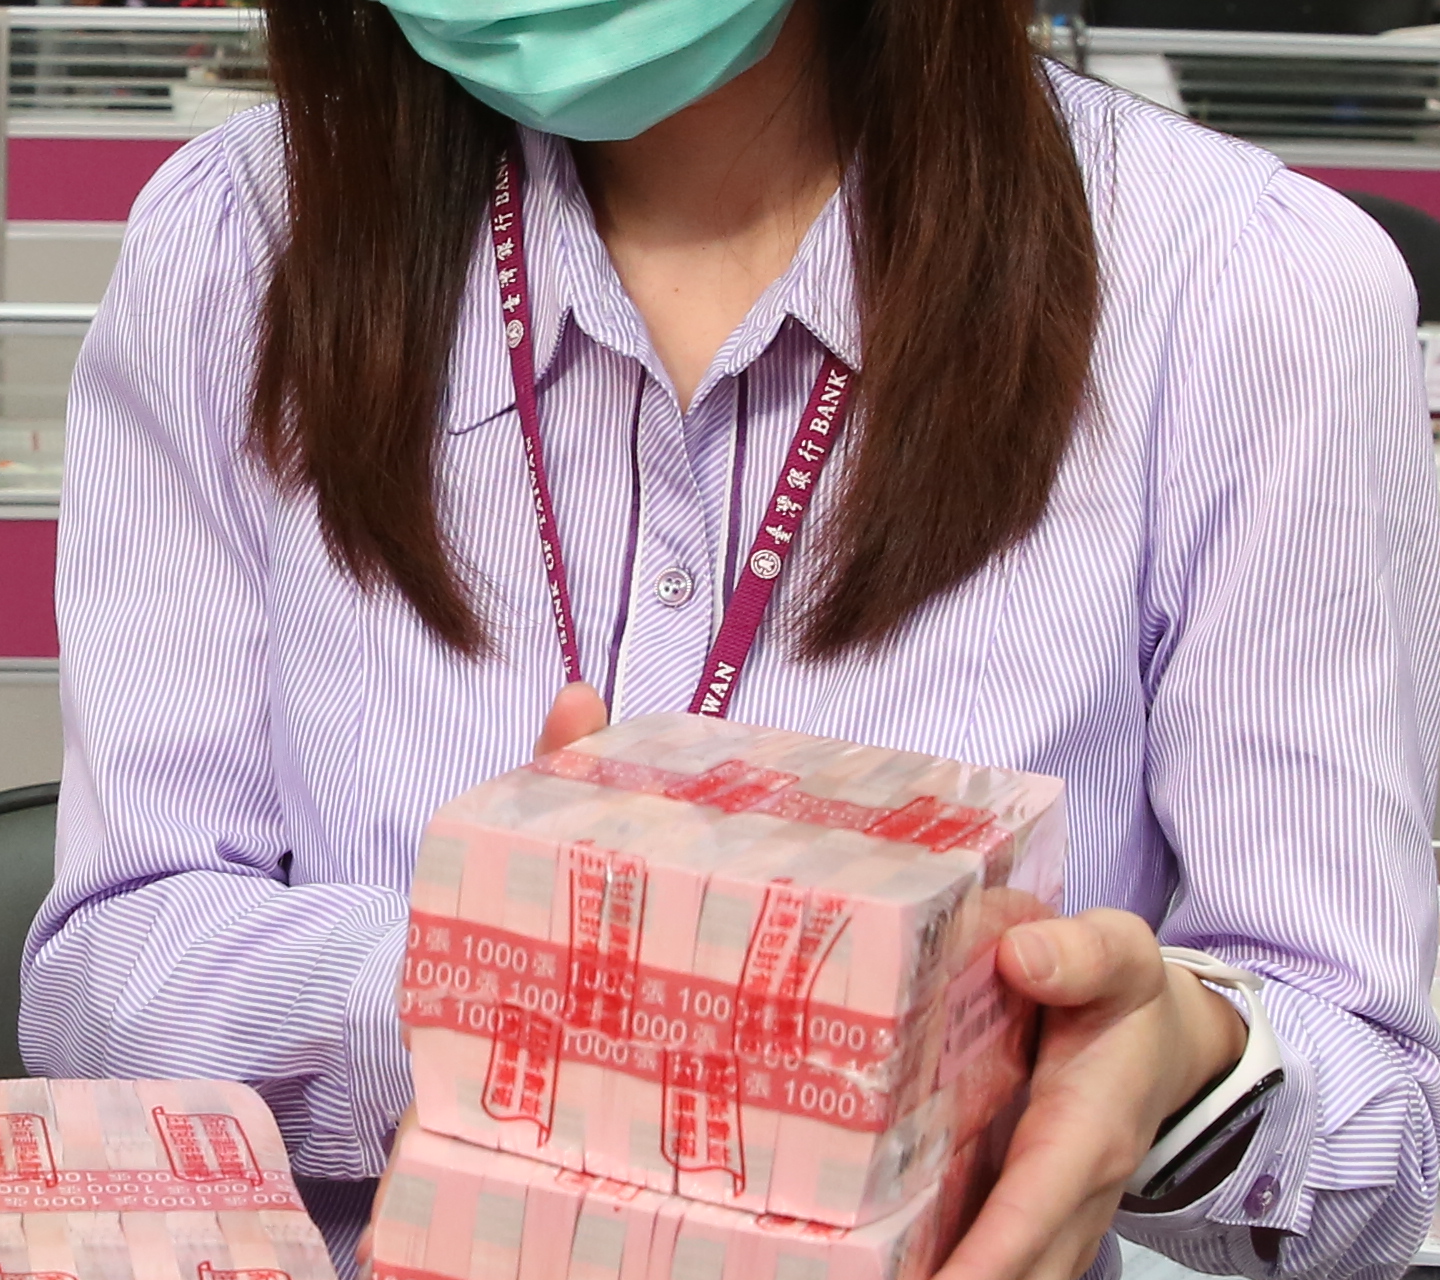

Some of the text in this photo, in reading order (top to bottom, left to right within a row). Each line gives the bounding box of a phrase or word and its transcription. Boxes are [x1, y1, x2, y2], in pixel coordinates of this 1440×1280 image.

[765, 369, 850, 544] 臺灣銀行 BANK
[523, 435, 569, 645] BANK OF TAIWAN
[462, 934, 556, 979] 1000 張
[784, 1082, 856, 1118] 1000
